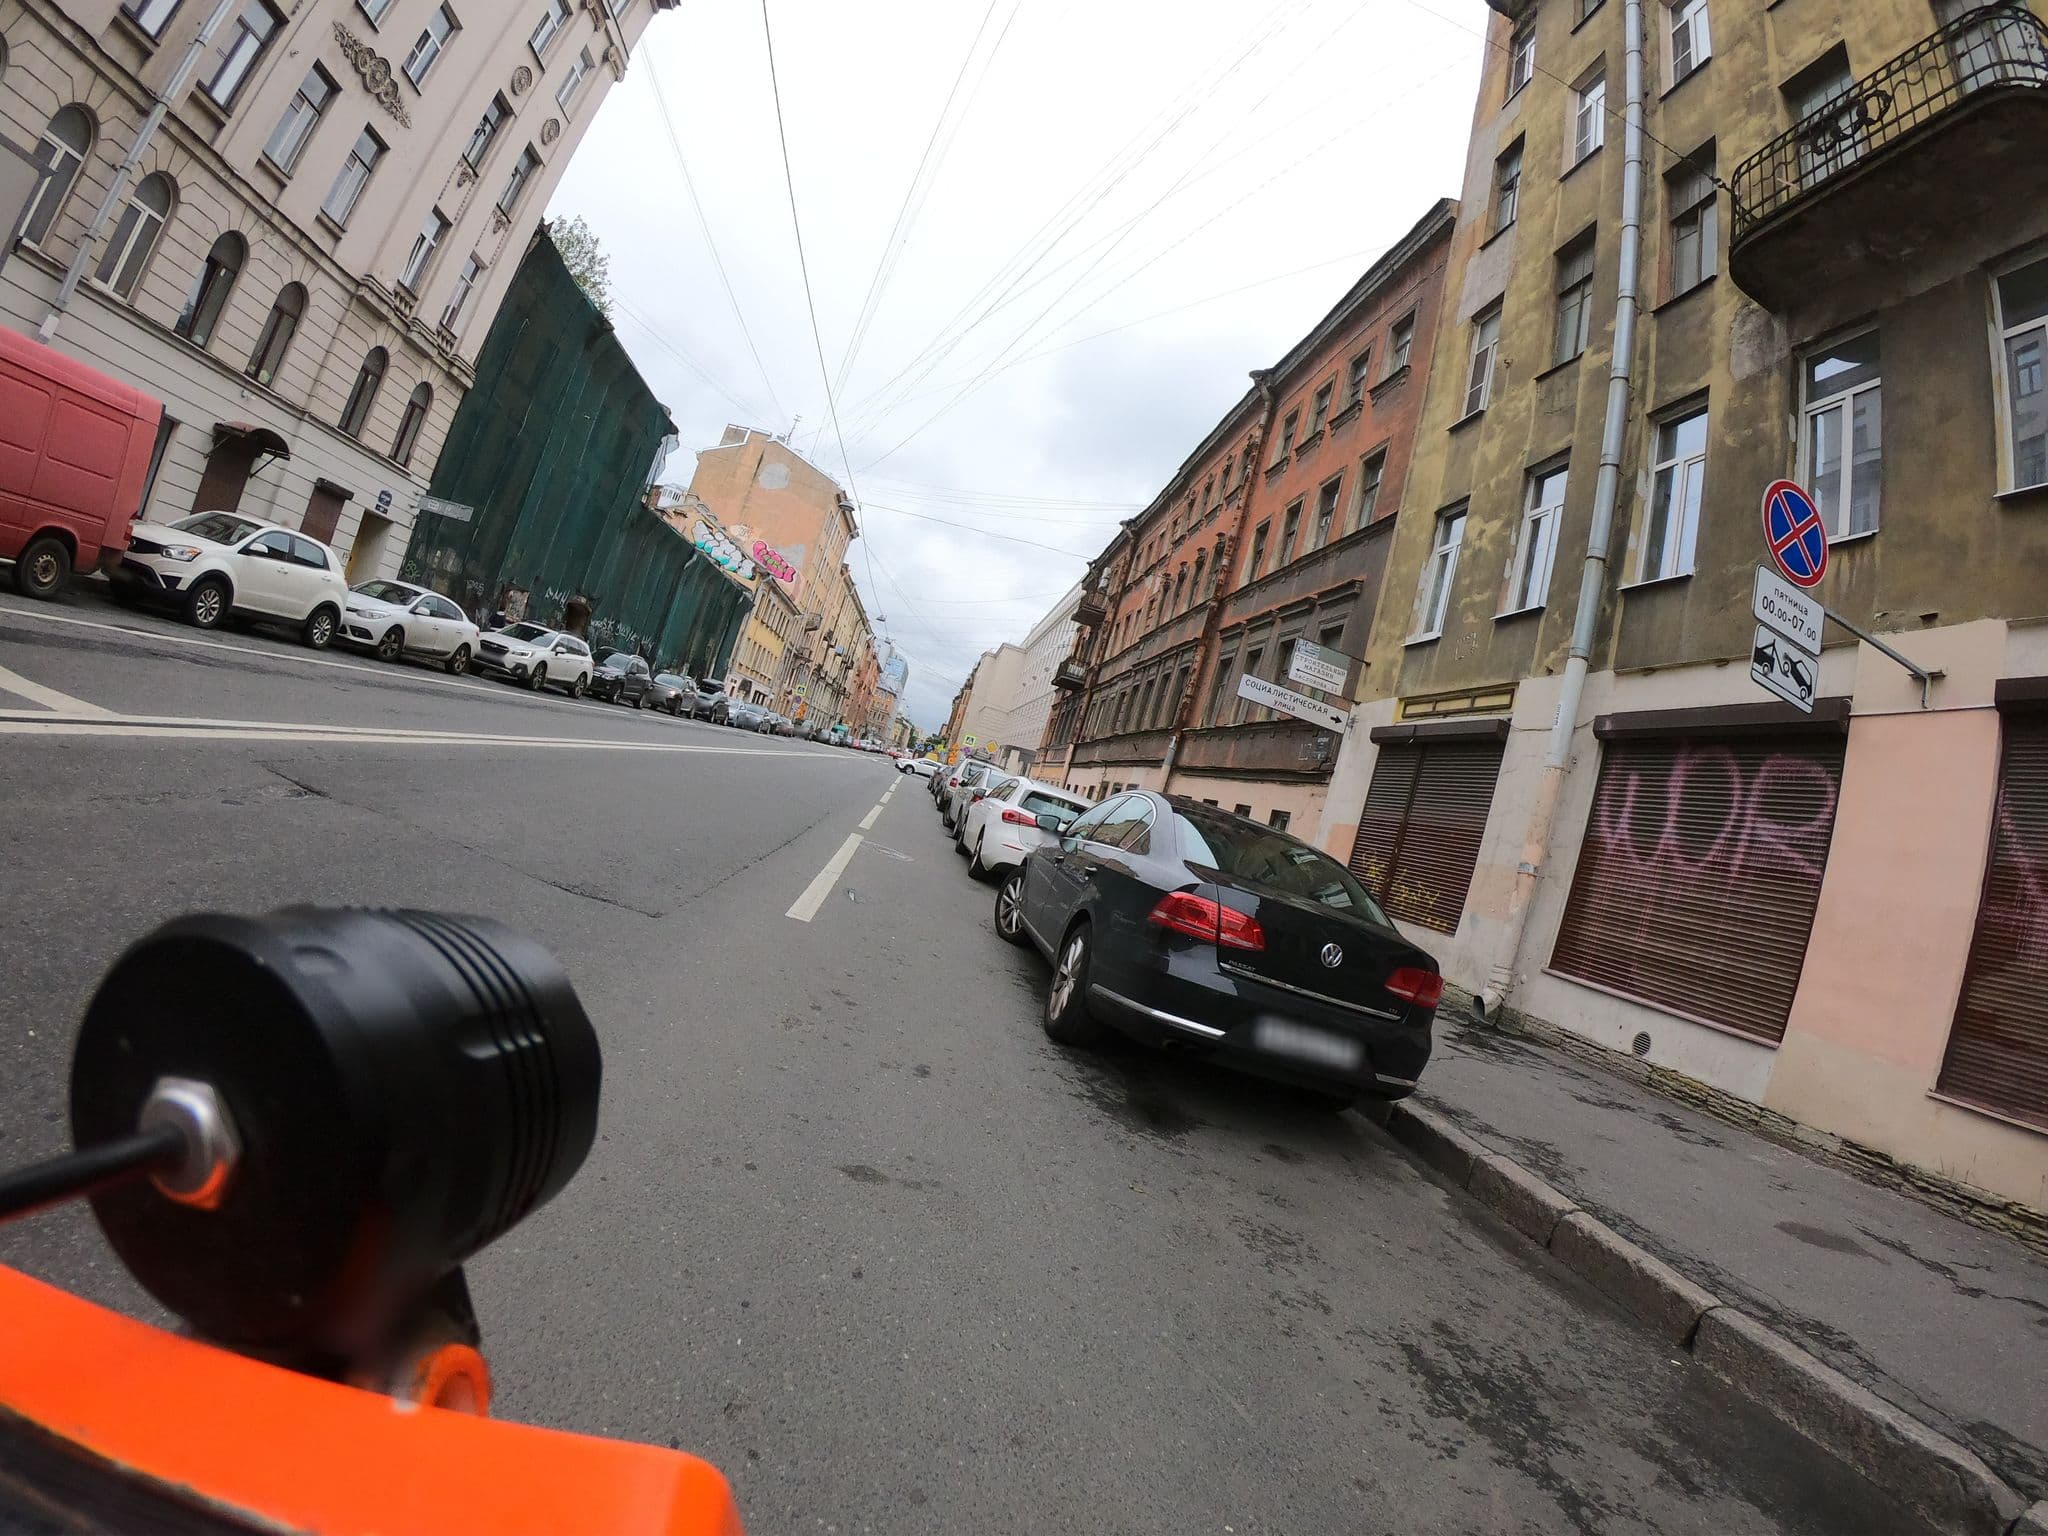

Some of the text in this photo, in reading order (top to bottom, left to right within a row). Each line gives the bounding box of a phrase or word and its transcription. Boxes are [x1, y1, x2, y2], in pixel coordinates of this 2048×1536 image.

[1774, 588, 1808, 615] пятница
[1245, 678, 1328, 715] СОЦИАЛИСТИЧЕСКАЯ
[1273, 699, 1296, 712] улица
